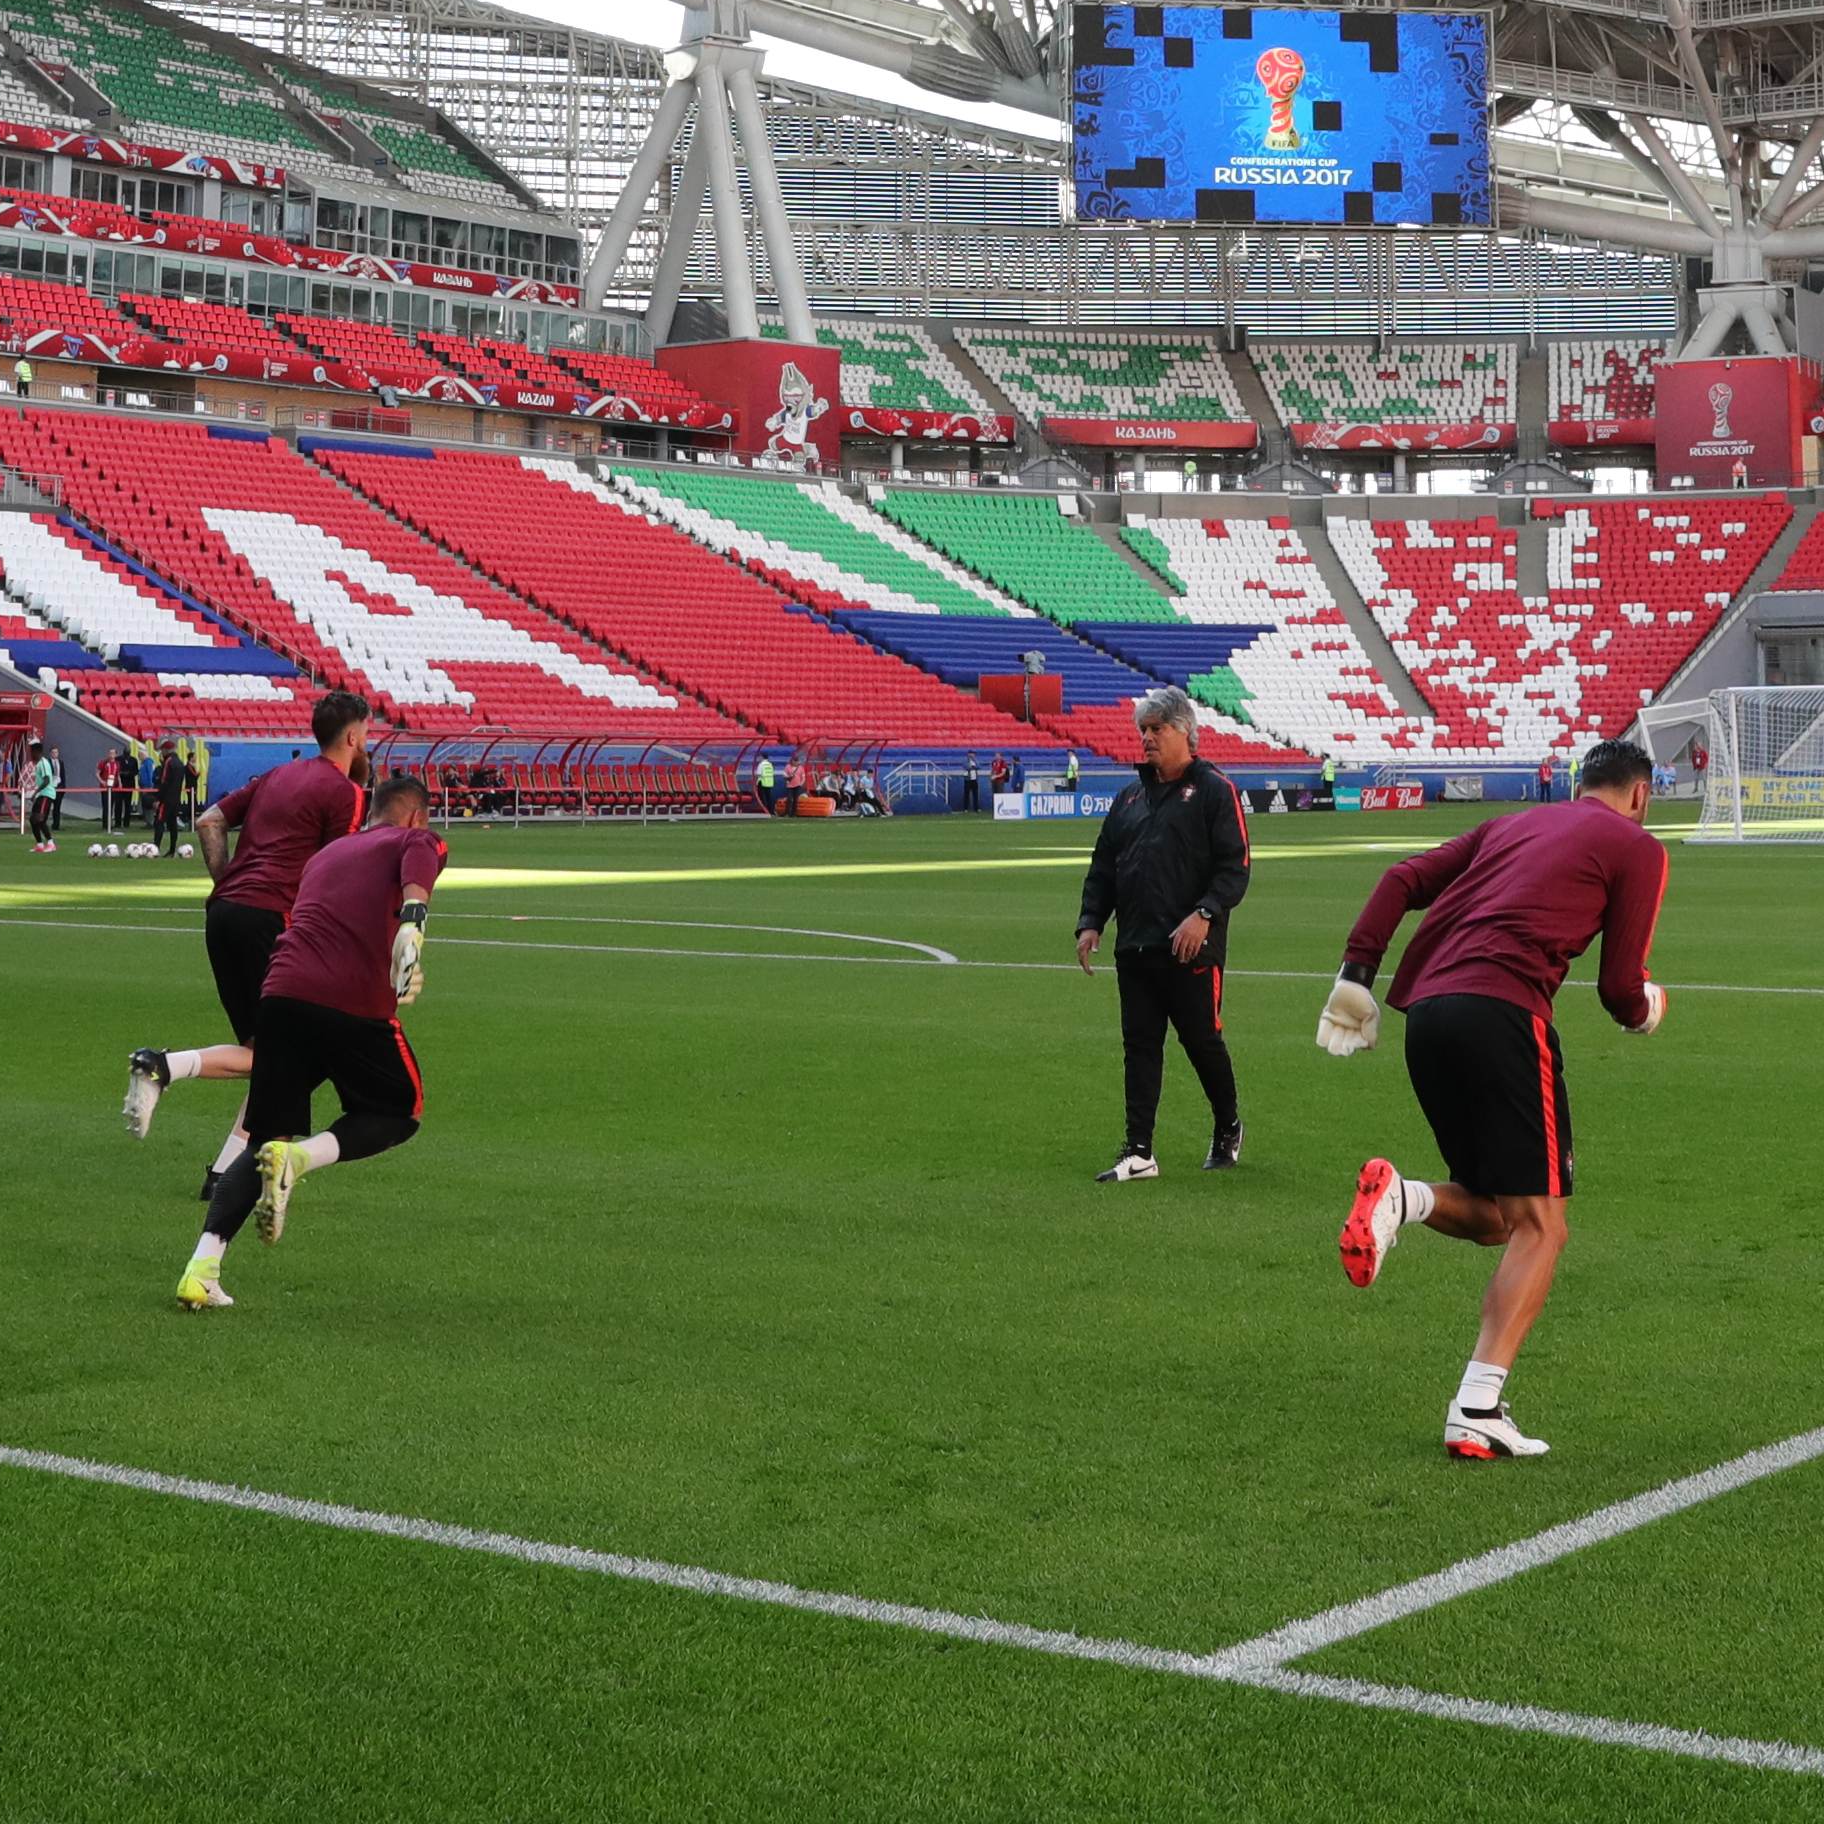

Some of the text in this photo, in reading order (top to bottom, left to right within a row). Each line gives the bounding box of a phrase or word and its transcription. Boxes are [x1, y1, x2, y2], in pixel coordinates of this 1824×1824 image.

[1271, 139, 1295, 148] FIFA
[1230, 156, 1338, 167] CONFEDERATIONS CUP
[1214, 167, 1353, 186] RUSSIA 2017
[517, 391, 555, 407] KAZAN
[1115, 426, 1177, 440] КАЗАНЬ
[1689, 445, 1755, 457] RUSSIA 2017
[1762, 780, 1824, 791] MY GAME
[1361, 788, 1424, 809] Bud Bud
[1762, 793, 1774, 803] IS
[1778, 793, 1806, 803] FAIR
[1030, 795, 1075, 816] GAZPROM
